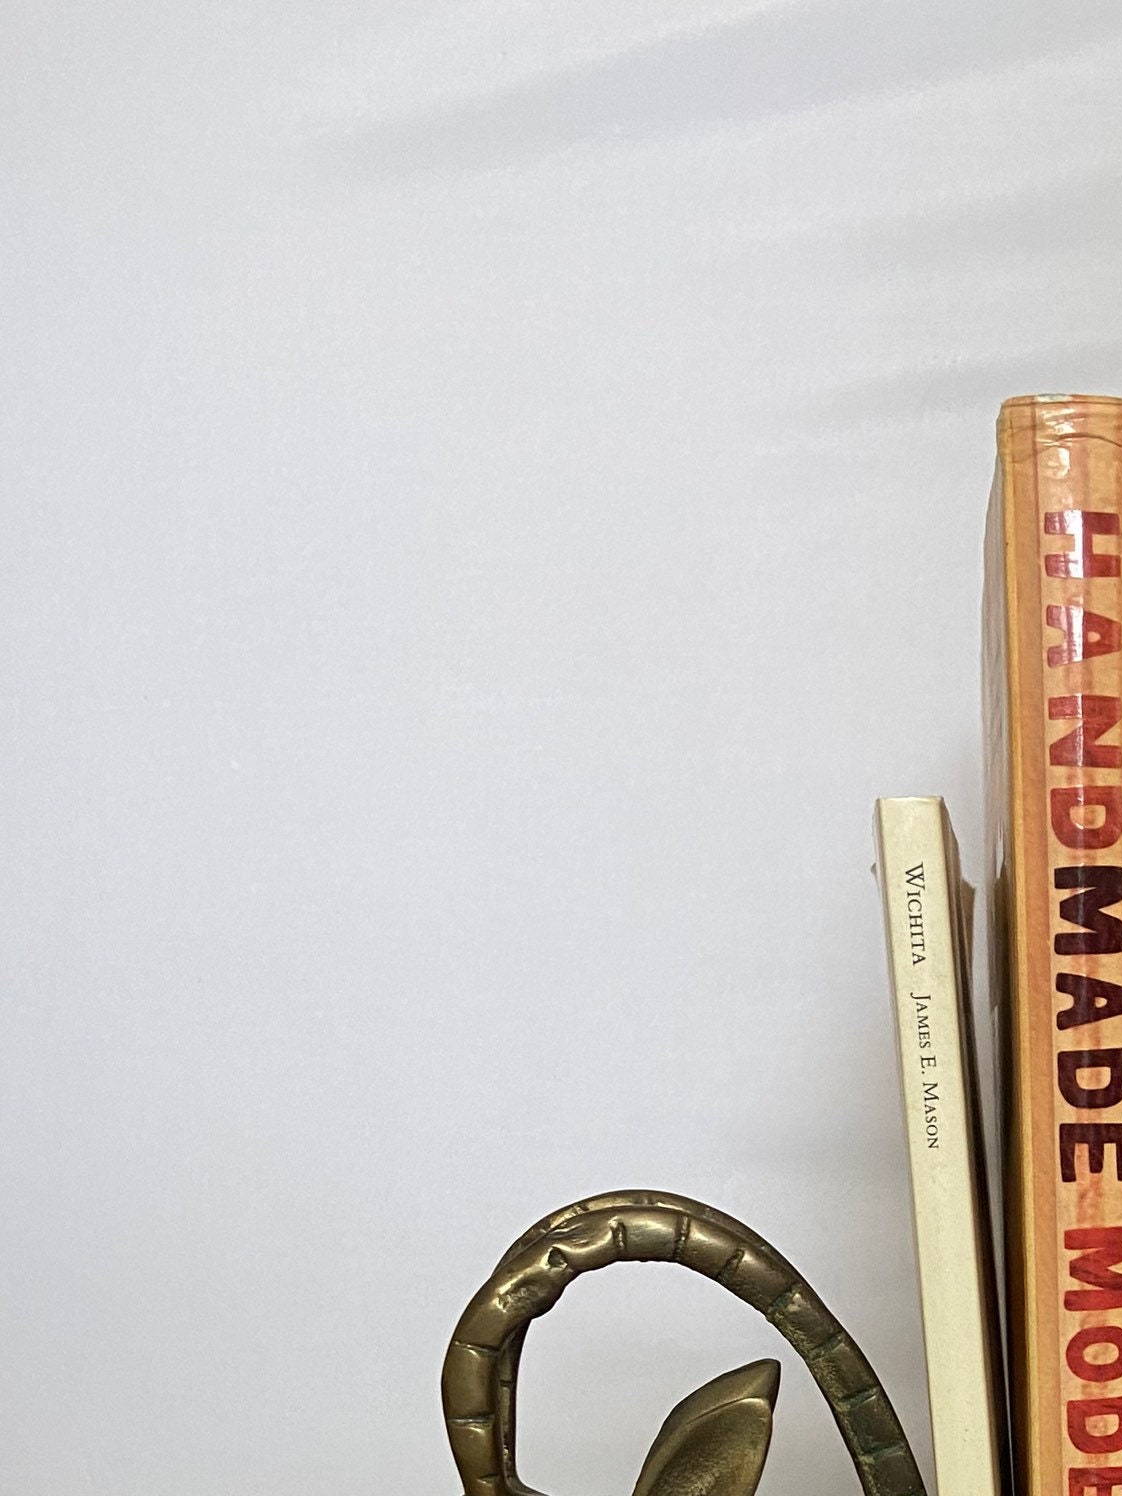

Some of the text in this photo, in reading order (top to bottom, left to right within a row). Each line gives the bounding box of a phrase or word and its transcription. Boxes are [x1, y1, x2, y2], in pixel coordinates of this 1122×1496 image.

[905, 862, 926, 966] WICHITA
[910, 992, 939, 1149] JAMES E. MASON
